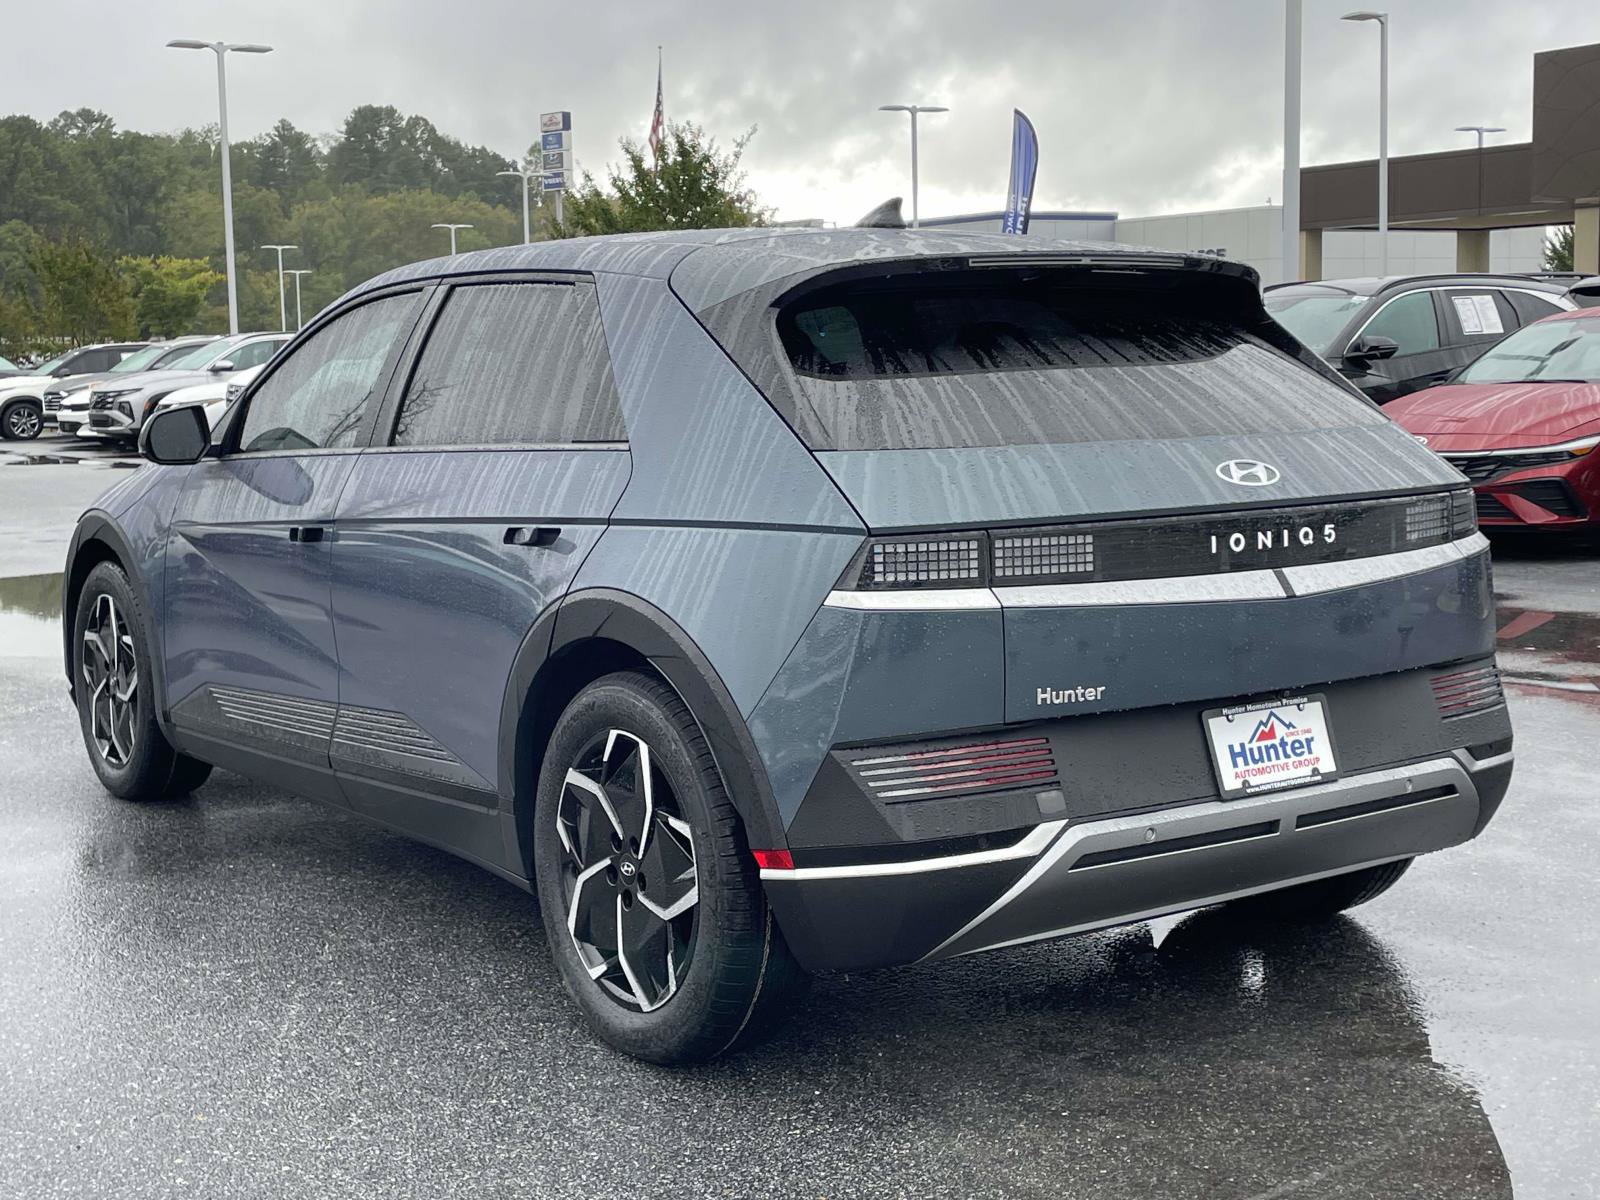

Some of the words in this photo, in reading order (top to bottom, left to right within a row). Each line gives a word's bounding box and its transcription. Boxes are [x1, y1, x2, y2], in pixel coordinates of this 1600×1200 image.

[1036, 685, 1106, 705] Hunter
[1222, 705, 1246, 716] Hunter
[1246, 701, 1281, 712] Hometown
[1282, 696, 1308, 706] Promise
[1227, 736, 1315, 769] Hunter
[1234, 761, 1291, 780] AUTOMOTIVE
[1292, 756, 1321, 769] GROUP
